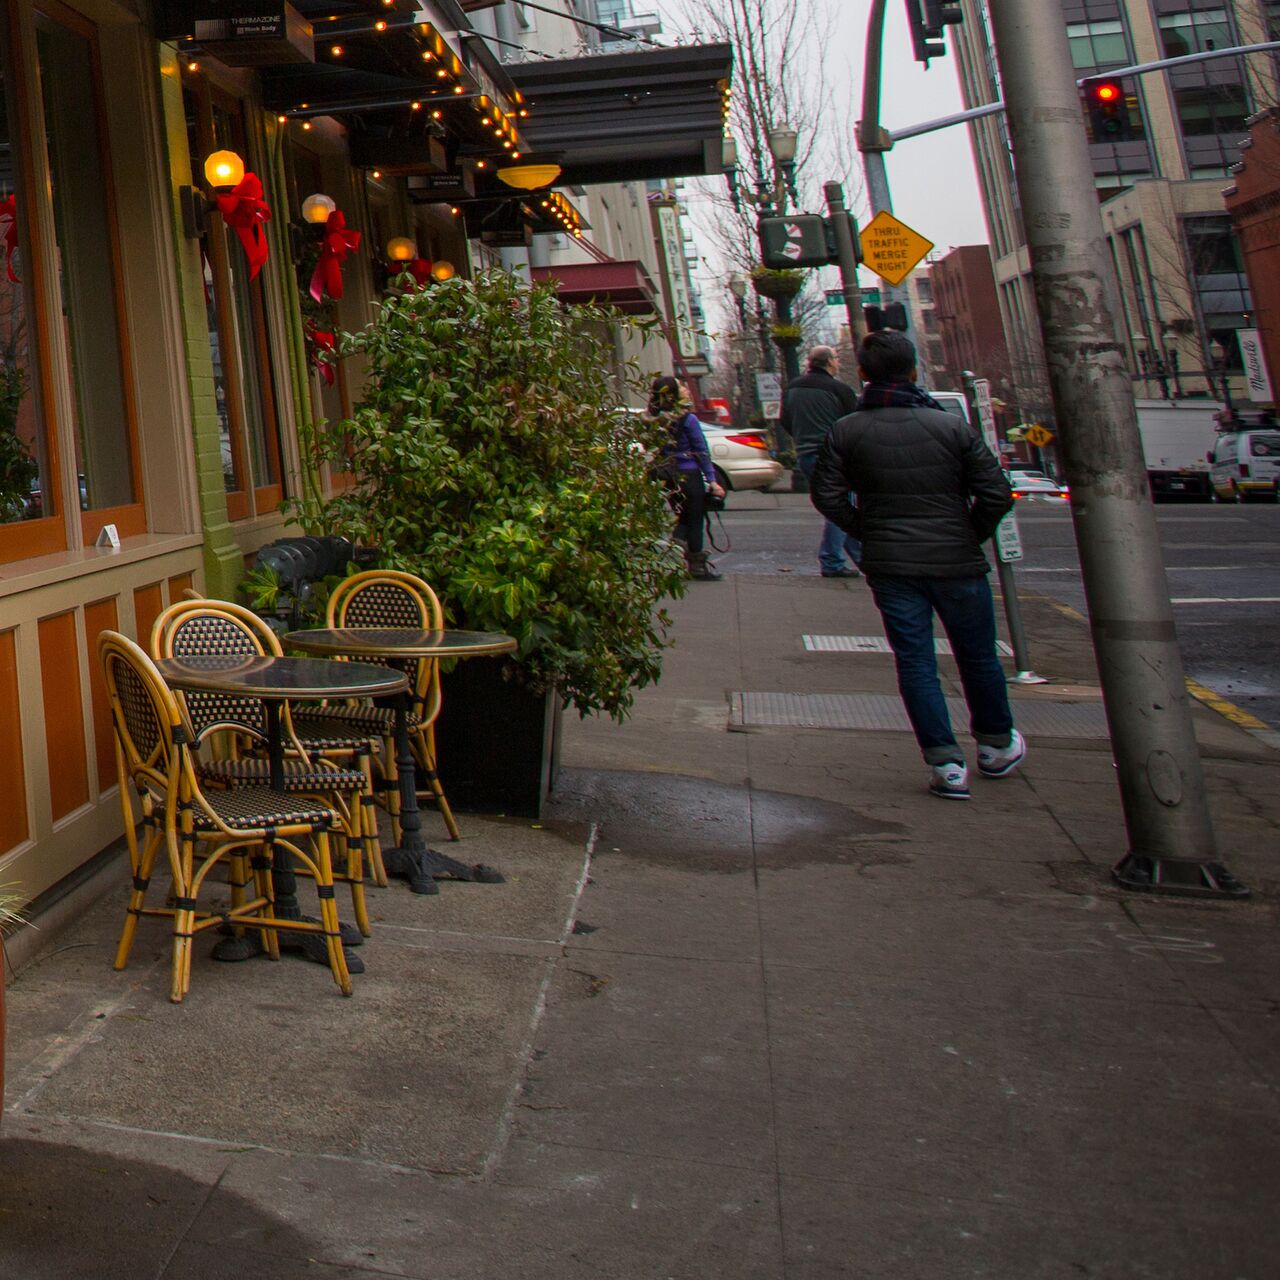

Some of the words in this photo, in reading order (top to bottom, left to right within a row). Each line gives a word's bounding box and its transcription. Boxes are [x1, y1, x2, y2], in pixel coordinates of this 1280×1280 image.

[873, 227, 900, 236] THRU
[869, 239, 909, 248] TRAFFIC
[873, 250, 908, 260] MERGE
[877, 261, 907, 271] RIGHT
